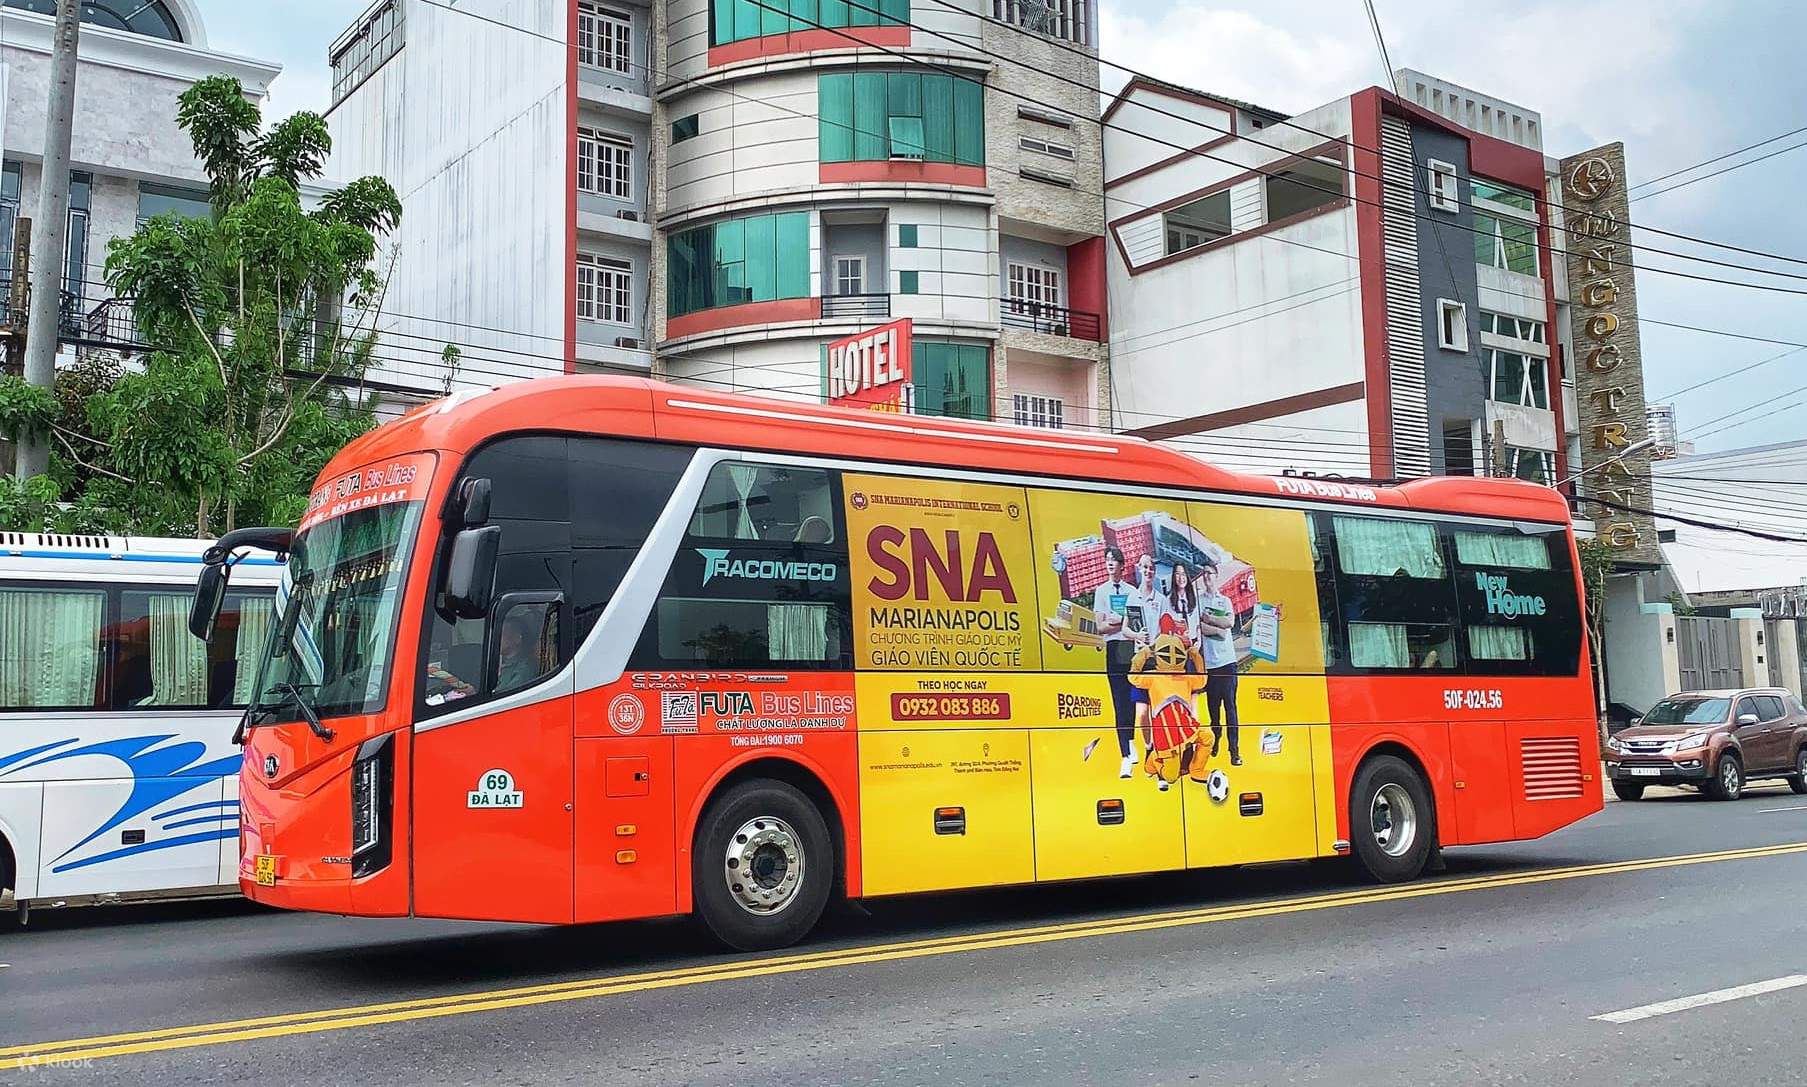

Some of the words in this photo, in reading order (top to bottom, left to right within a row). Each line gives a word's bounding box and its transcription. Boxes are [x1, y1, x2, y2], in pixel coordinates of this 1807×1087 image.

[830, 327, 904, 398] HOTEL
[335, 472, 362, 501] FUTA
[364, 468, 384, 491] Bus
[383, 462, 417, 487] Lines
[694, 548, 837, 588] TRACOMECO
[867, 525, 1018, 604] SNA
[1475, 571, 1508, 591] New
[1485, 589, 1546, 620] Home
[870, 608, 1020, 631] MARIANAPOLIS
[870, 632, 920, 644] CHƯƠNG
[923, 631, 953, 644] TRÌNH
[956, 631, 981, 646] GIÁO
[871, 646, 911, 665] GIÁO
[915, 646, 950, 666] VIÊN
[954, 647, 1000, 667] QUỐC
[1003, 647, 1022, 666] TẾ
[917, 681, 941, 689] THEO
[943, 681, 962, 692] HỌC
[964, 681, 987, 689] NGAY
[700, 691, 756, 716] FUTA
[761, 691, 801, 715] Bus
[803, 691, 854, 714] Lines
[900, 698, 938, 716] 0932
[940, 698, 969, 715] 083
[972, 698, 1000, 715] 886
[1057, 693, 1102, 707] BOARDING
[1443, 690, 1502, 709] 50F-024.56
[1058, 706, 1101, 719] FACILITIES
[486, 774, 508, 790] 69
[471, 791, 490, 805] ĐÀ
[495, 794, 520, 807] LẠT
